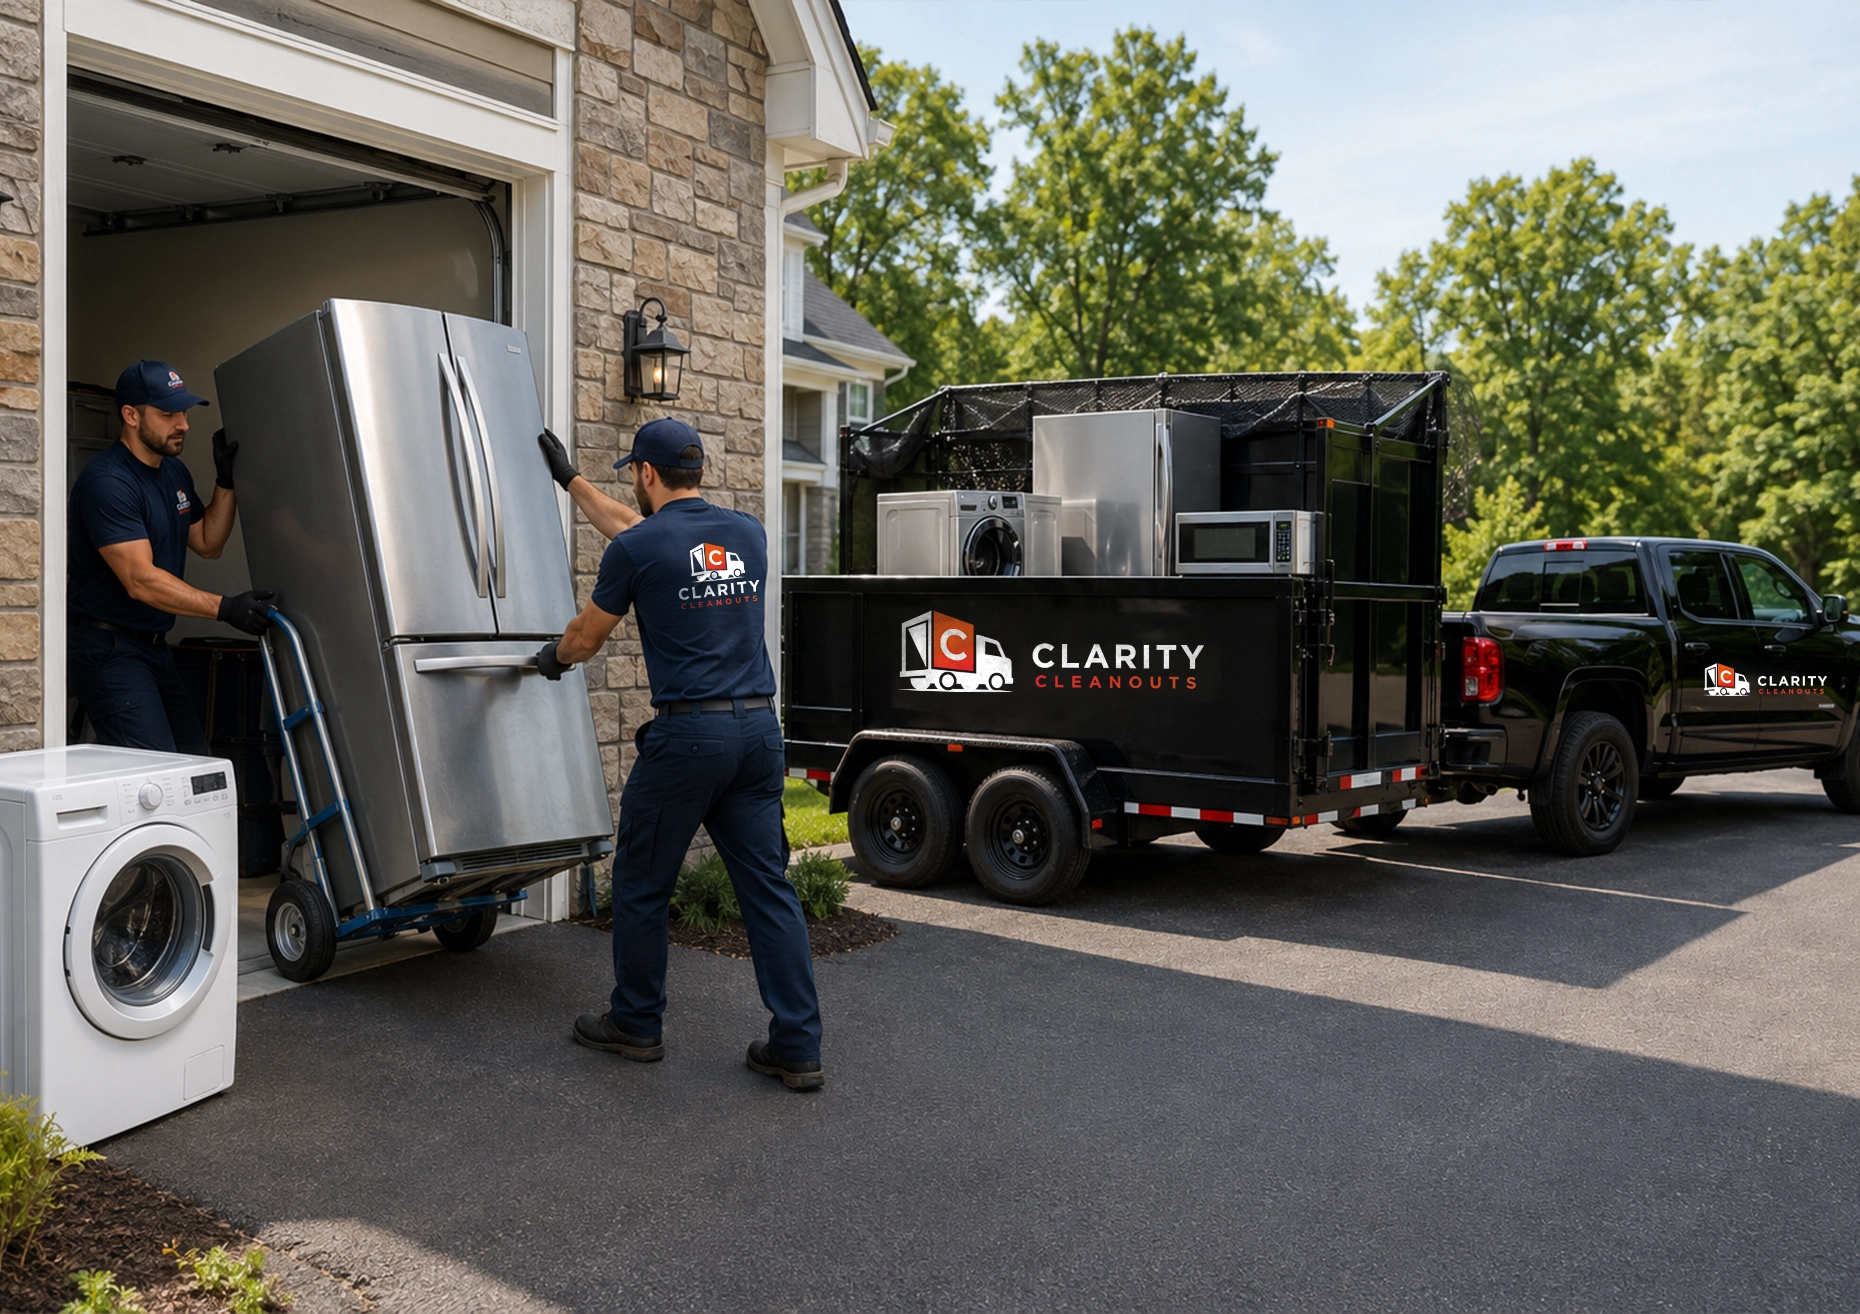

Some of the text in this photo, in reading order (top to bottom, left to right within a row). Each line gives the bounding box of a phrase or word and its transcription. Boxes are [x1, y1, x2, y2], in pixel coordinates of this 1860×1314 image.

[709, 550, 723, 566] C
[678, 580, 760, 601] CLARITY
[680, 595, 759, 610] CLEANOUTS
[939, 628, 968, 661] C
[1032, 643, 1205, 669] CLARITY
[1035, 675, 1197, 690] CLEANOUTS
[1720, 670, 1732, 684] C
[1757, 675, 1828, 687] CLARITY
